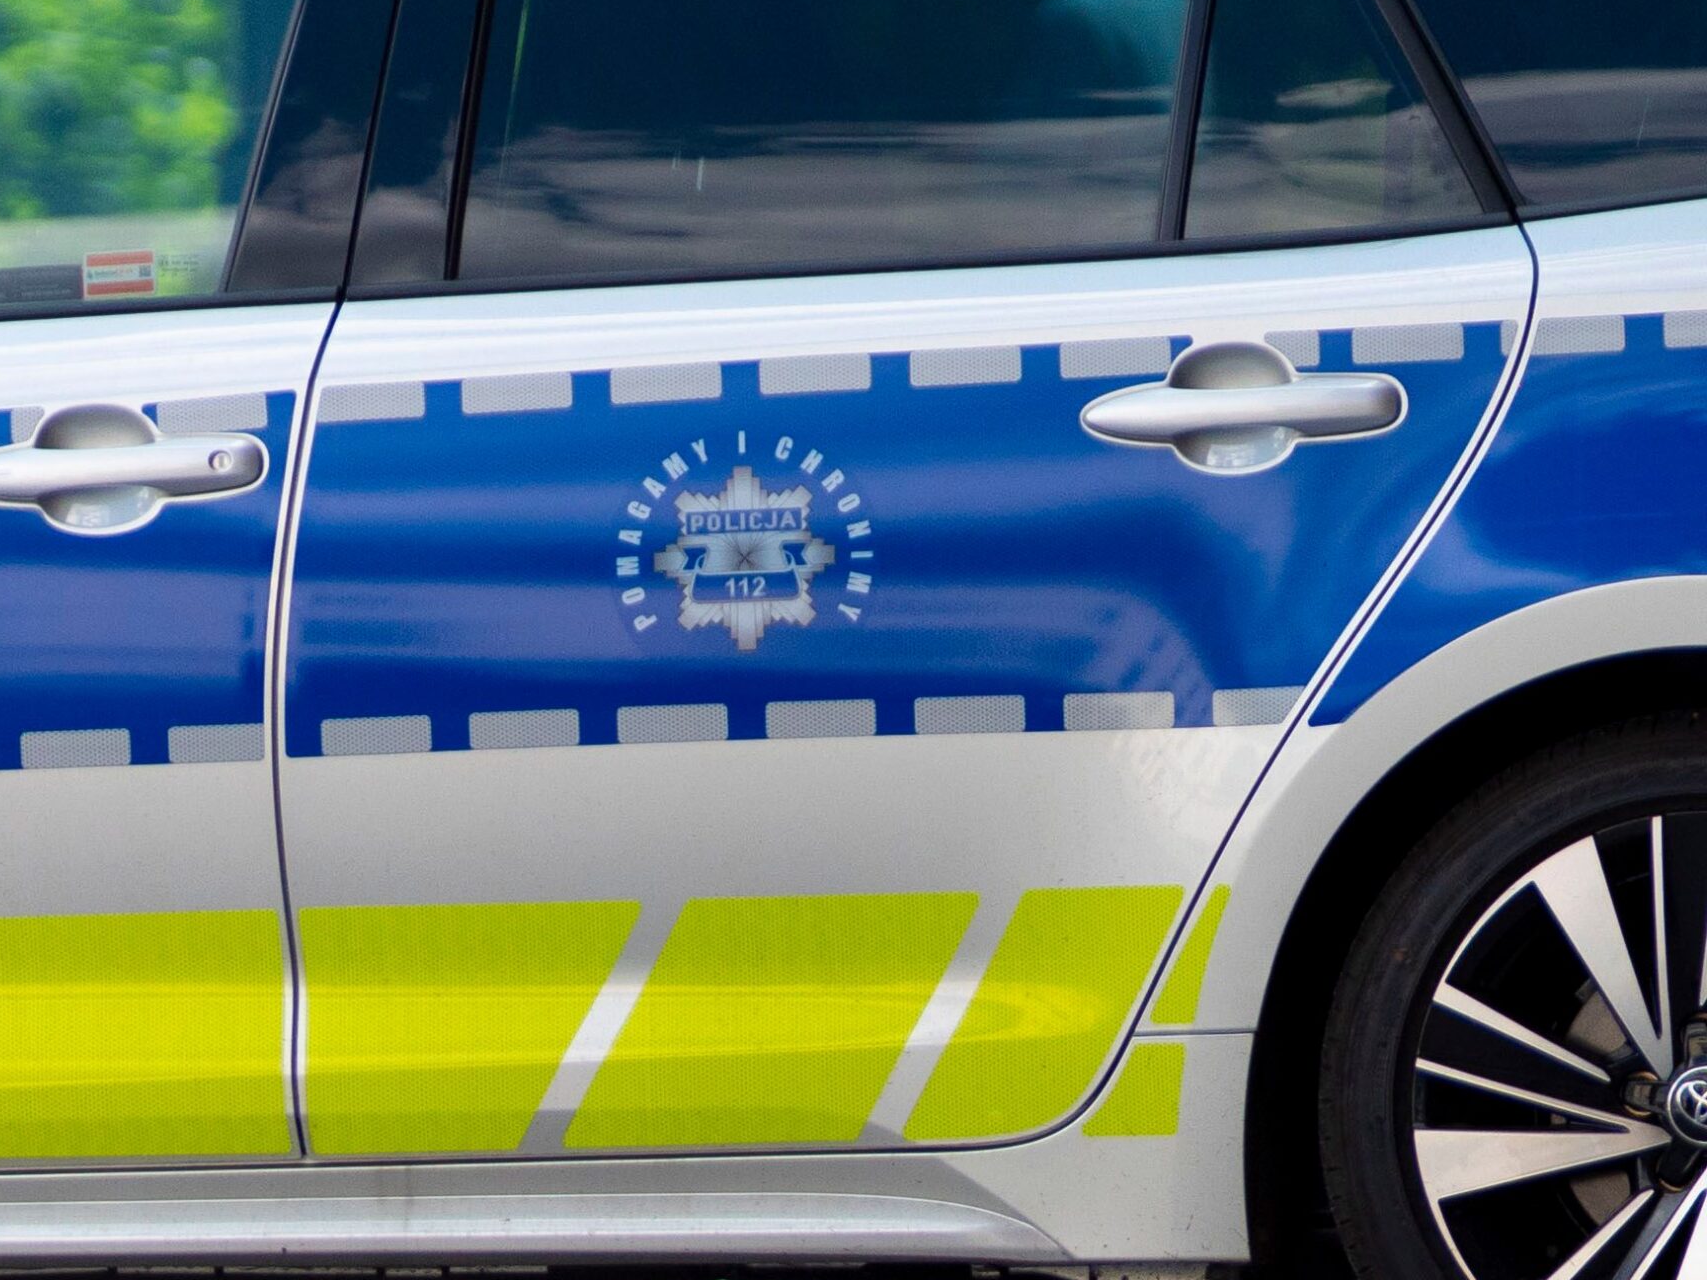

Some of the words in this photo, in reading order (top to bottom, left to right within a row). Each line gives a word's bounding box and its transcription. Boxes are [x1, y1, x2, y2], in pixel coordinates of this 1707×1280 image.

[617, 439, 709, 631] POMAGAMY
[738, 431, 746, 454] I
[775, 436, 873, 622] CHRONIMY
[690, 511, 796, 532] POLICJA
[726, 578, 767, 597] 112
